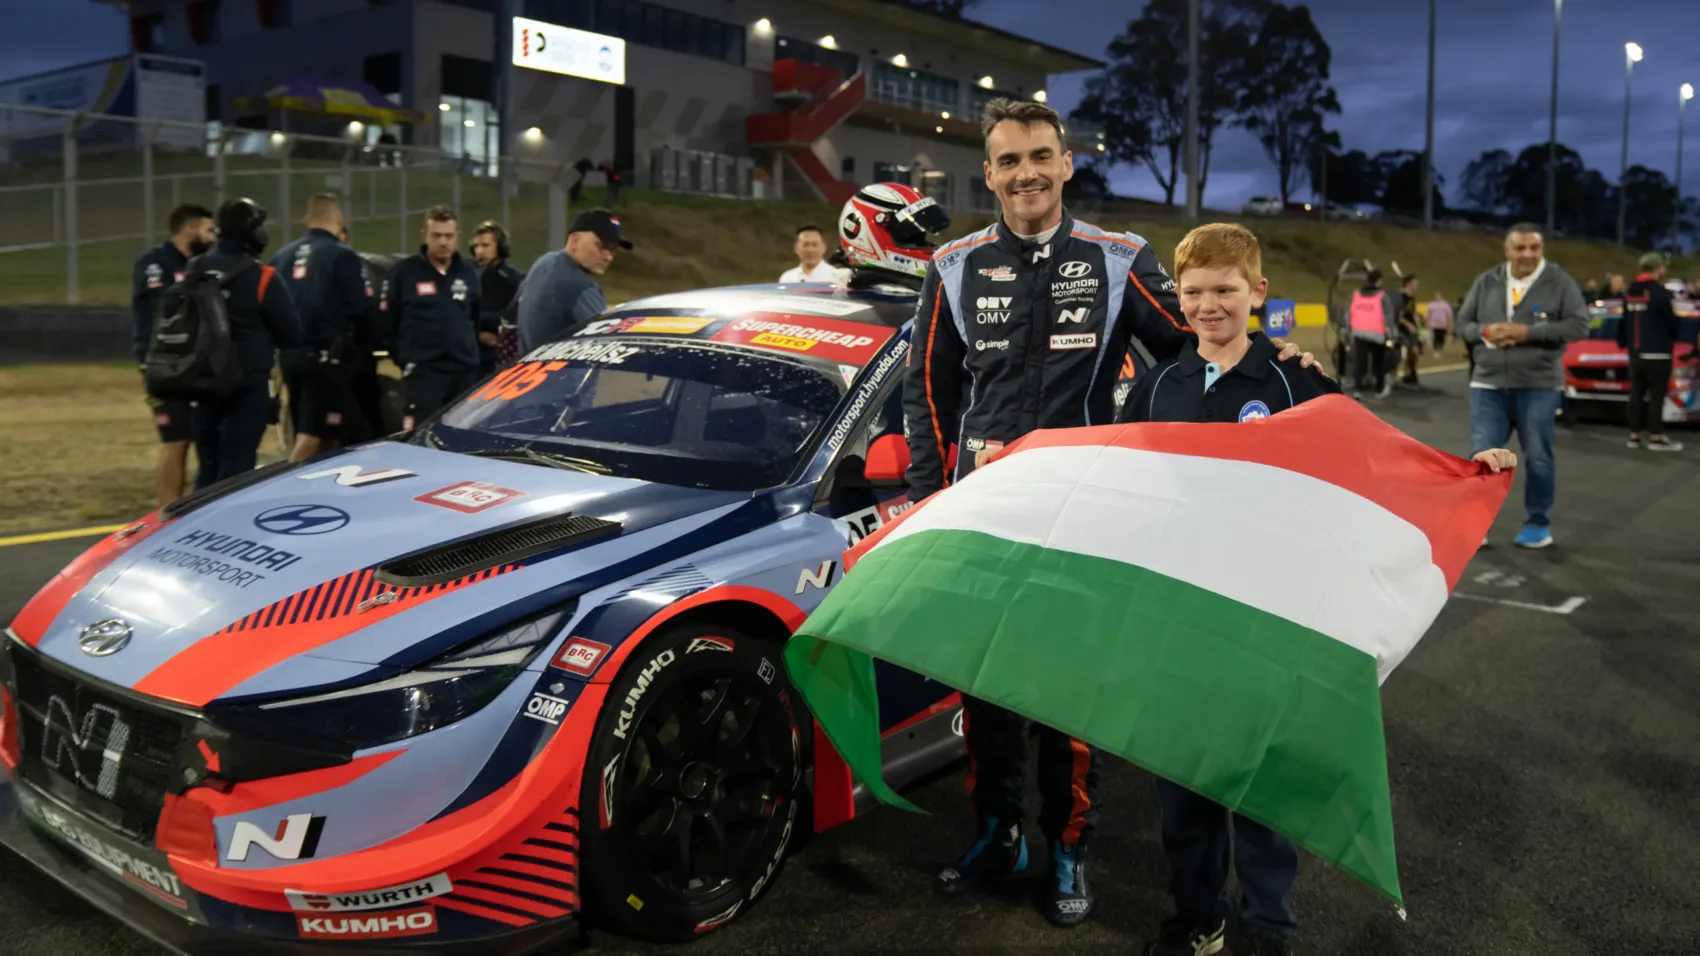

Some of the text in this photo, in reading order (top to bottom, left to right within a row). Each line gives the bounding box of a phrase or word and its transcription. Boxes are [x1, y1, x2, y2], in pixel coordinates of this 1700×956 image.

[1109, 243, 1134, 258] OMP
[1051, 279, 1099, 291] HYUNDAI
[1052, 287, 1098, 298] MOTORSPORT
[977, 312, 1011, 325] OMV
[731, 318, 874, 349] SUPERCHEAP
[761, 335, 808, 348] AUTO
[986, 339, 1010, 350] simple
[1052, 337, 1094, 346] KUMHO
[467, 361, 570, 401] 105
[827, 339, 909, 450] motorsport.hyundai.com
[966, 438, 985, 451] OMP
[448, 488, 492, 503] BRC
[175, 530, 303, 572] HYUNDAI
[146, 547, 266, 589] MOTORSPORT
[567, 646, 594, 662] BRC
[613, 648, 676, 740] KUMHO
[527, 697, 566, 719] OMP
[336, 882, 434, 908] WÜRTH
[1057, 900, 1089, 913] OMP
[301, 911, 434, 934] KUMHO
